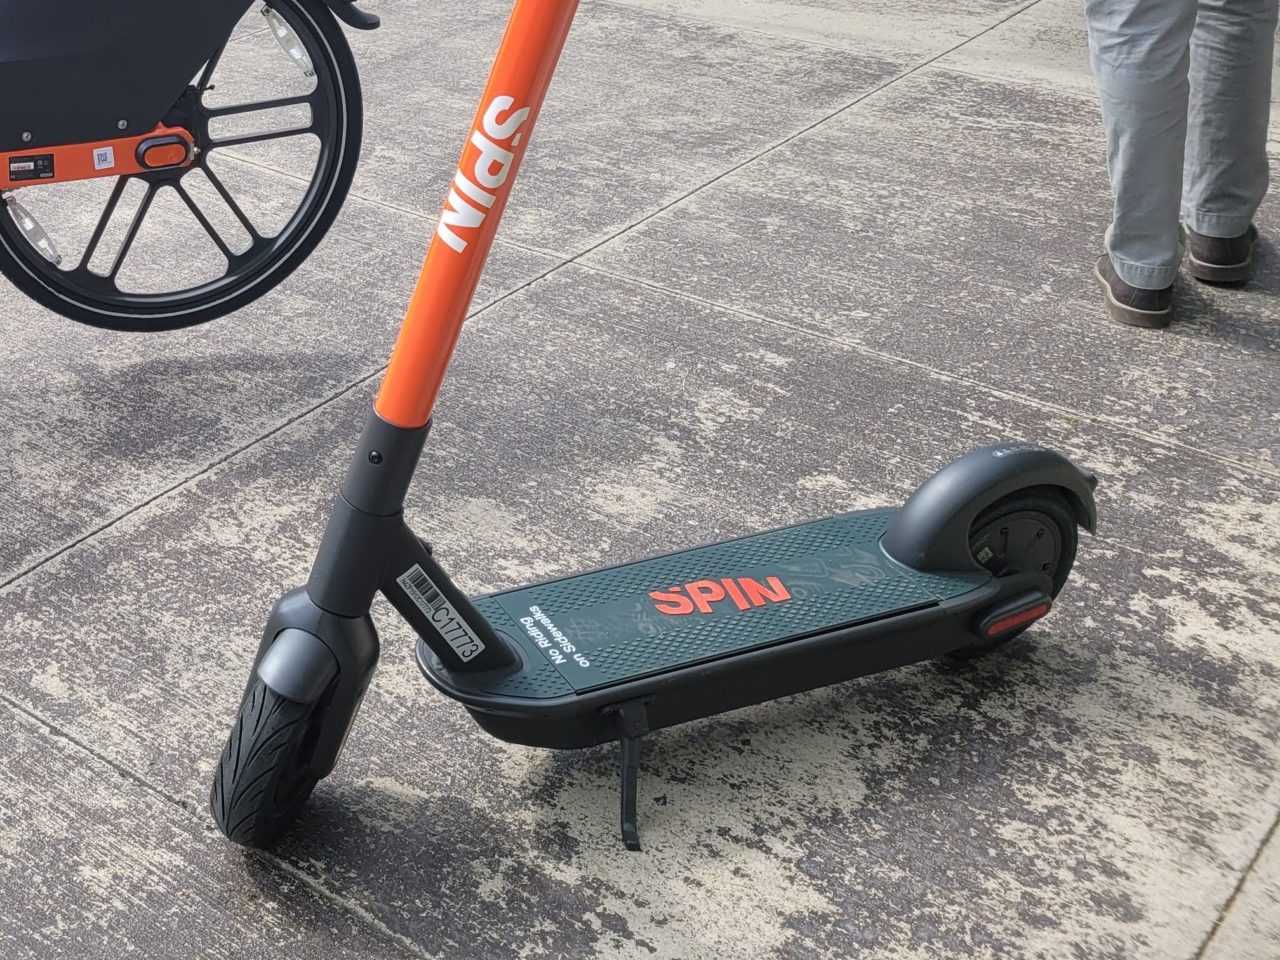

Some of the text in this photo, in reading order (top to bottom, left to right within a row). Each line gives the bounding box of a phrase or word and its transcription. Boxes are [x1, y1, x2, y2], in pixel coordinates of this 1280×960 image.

[437, 95, 531, 254] SPIN
[648, 576, 792, 615] SPIN
[431, 607, 479, 658] C17773
[520, 616, 567, 665] No Riding
[529, 605, 590, 668] on Sidewalks
